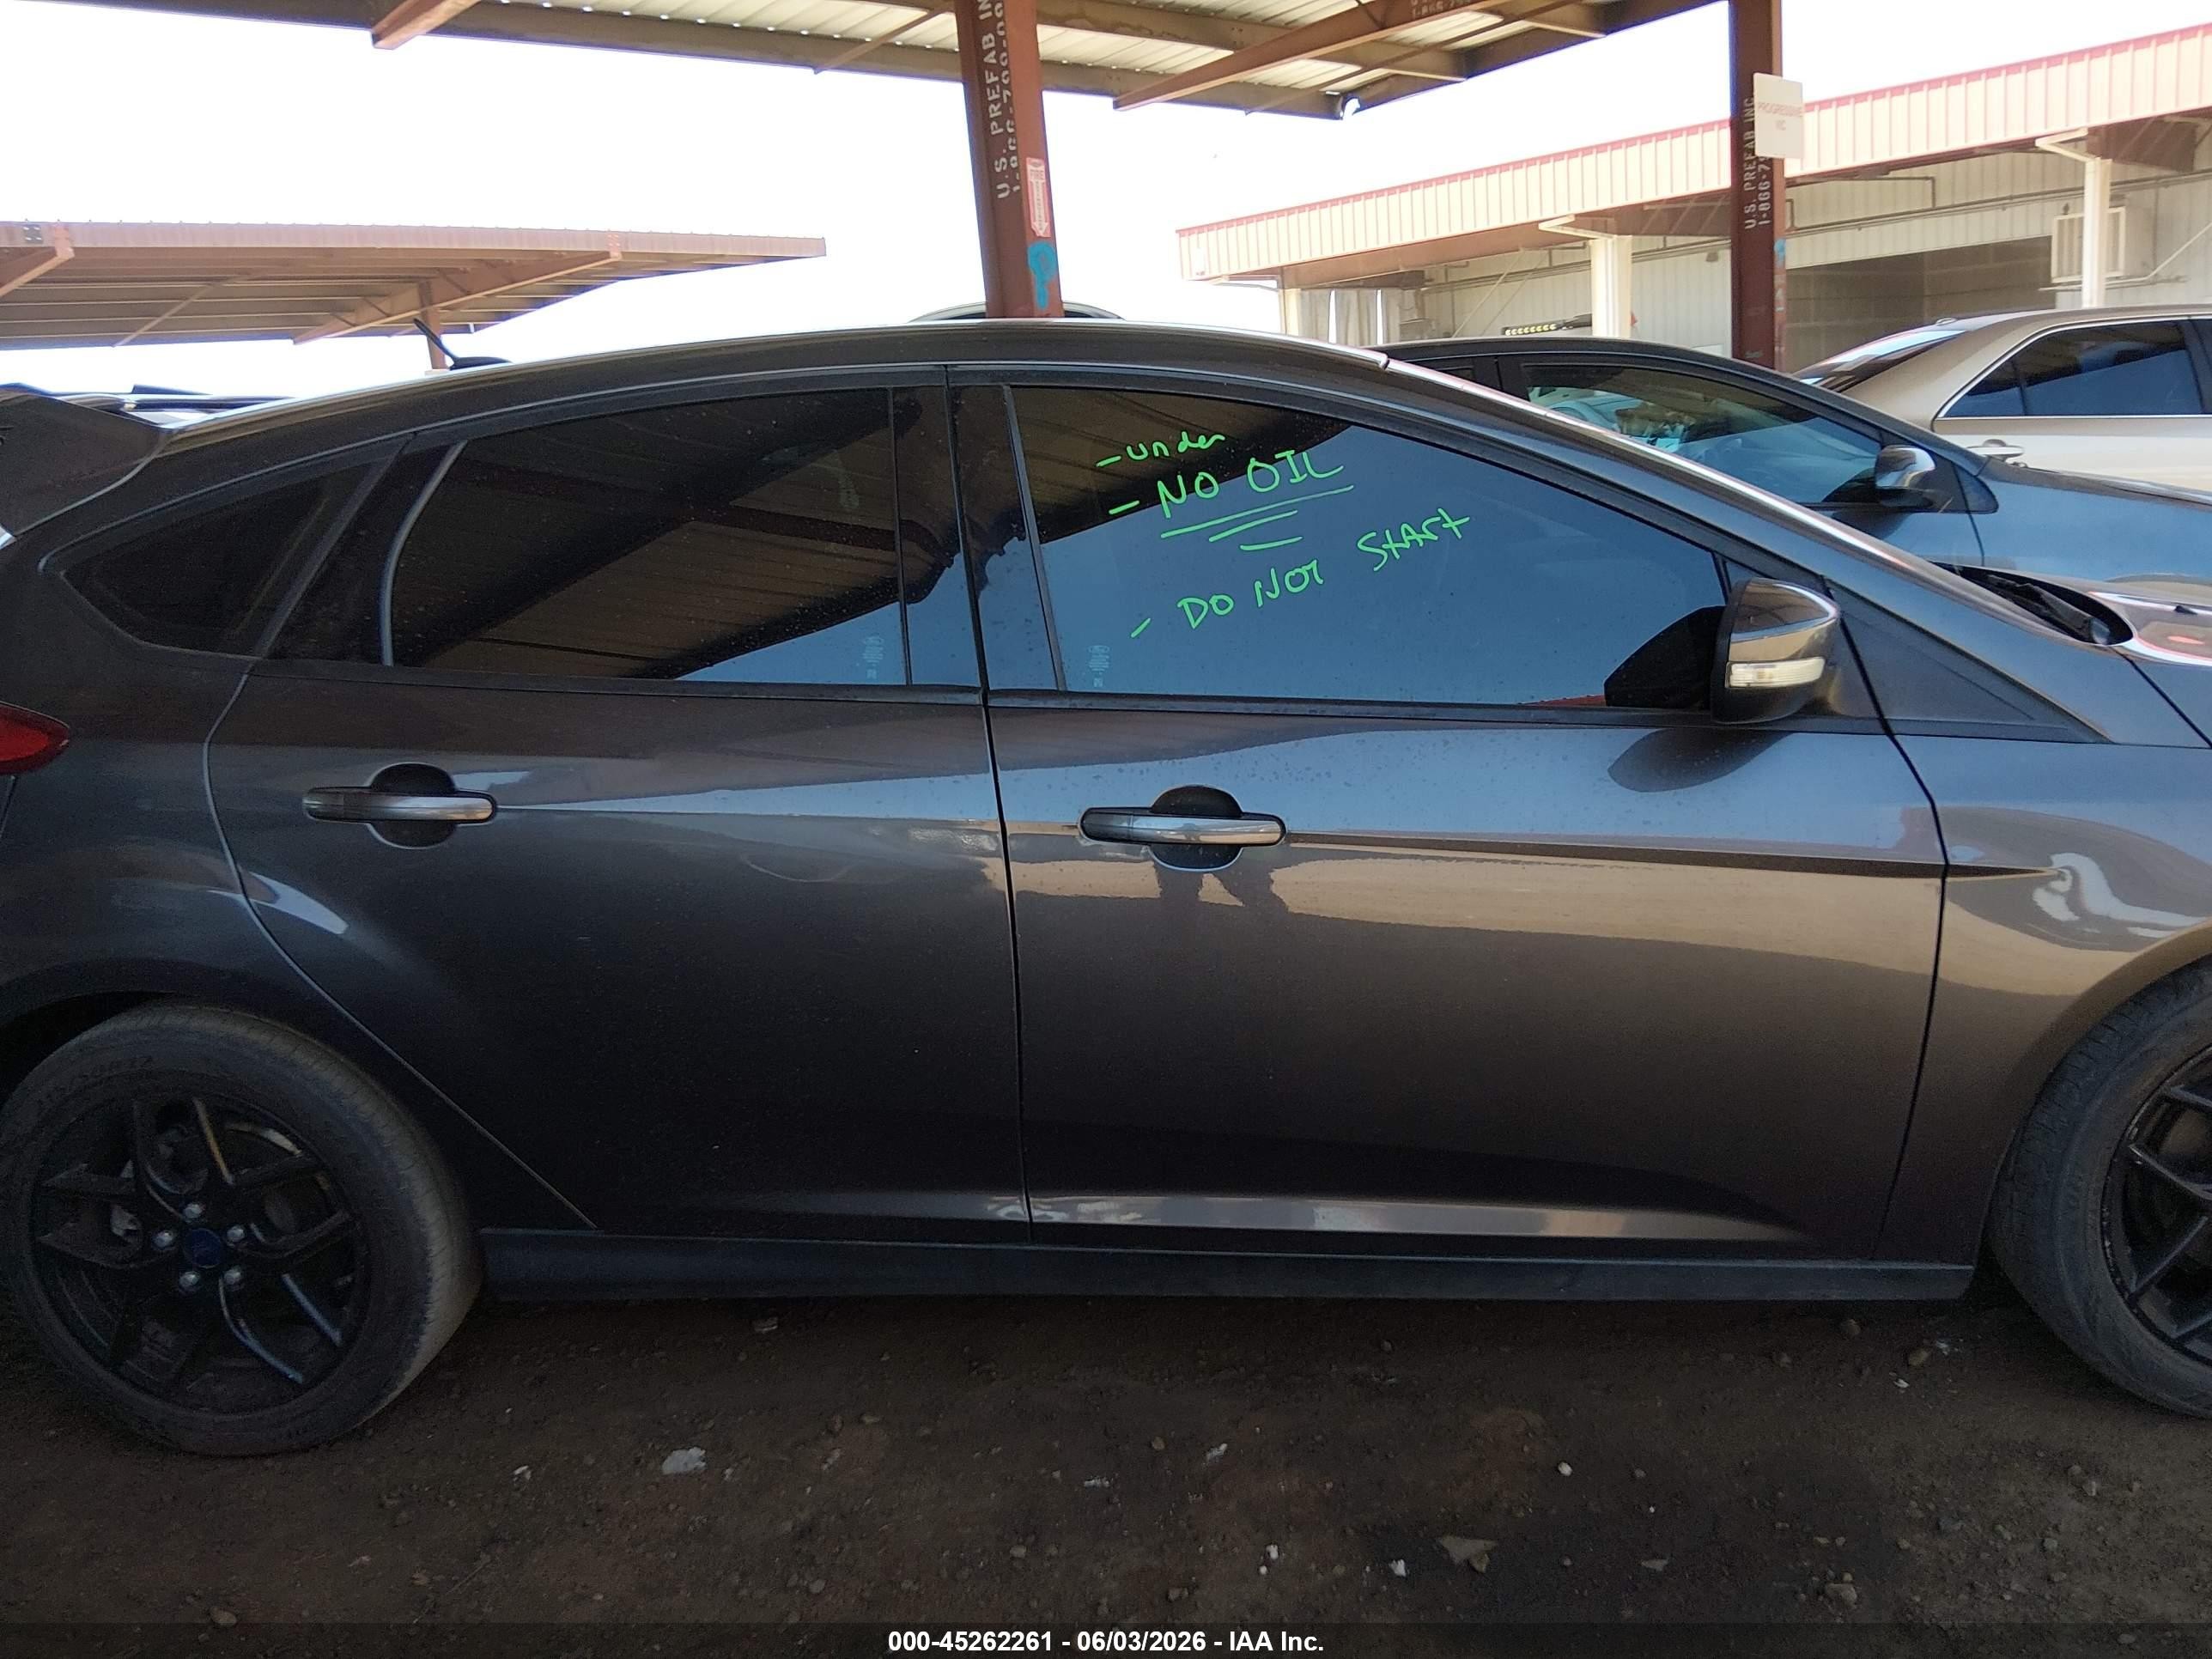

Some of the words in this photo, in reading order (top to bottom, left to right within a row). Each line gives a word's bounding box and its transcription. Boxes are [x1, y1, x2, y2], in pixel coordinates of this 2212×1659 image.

[981, 33, 1004, 136] PREFAB
[994, 148, 1011, 199] U.S.
[1157, 471, 1220, 519] NO
[1246, 449, 1344, 493] OIL
[1176, 593, 1235, 629] DO
[1253, 559, 1324, 608] NOT
